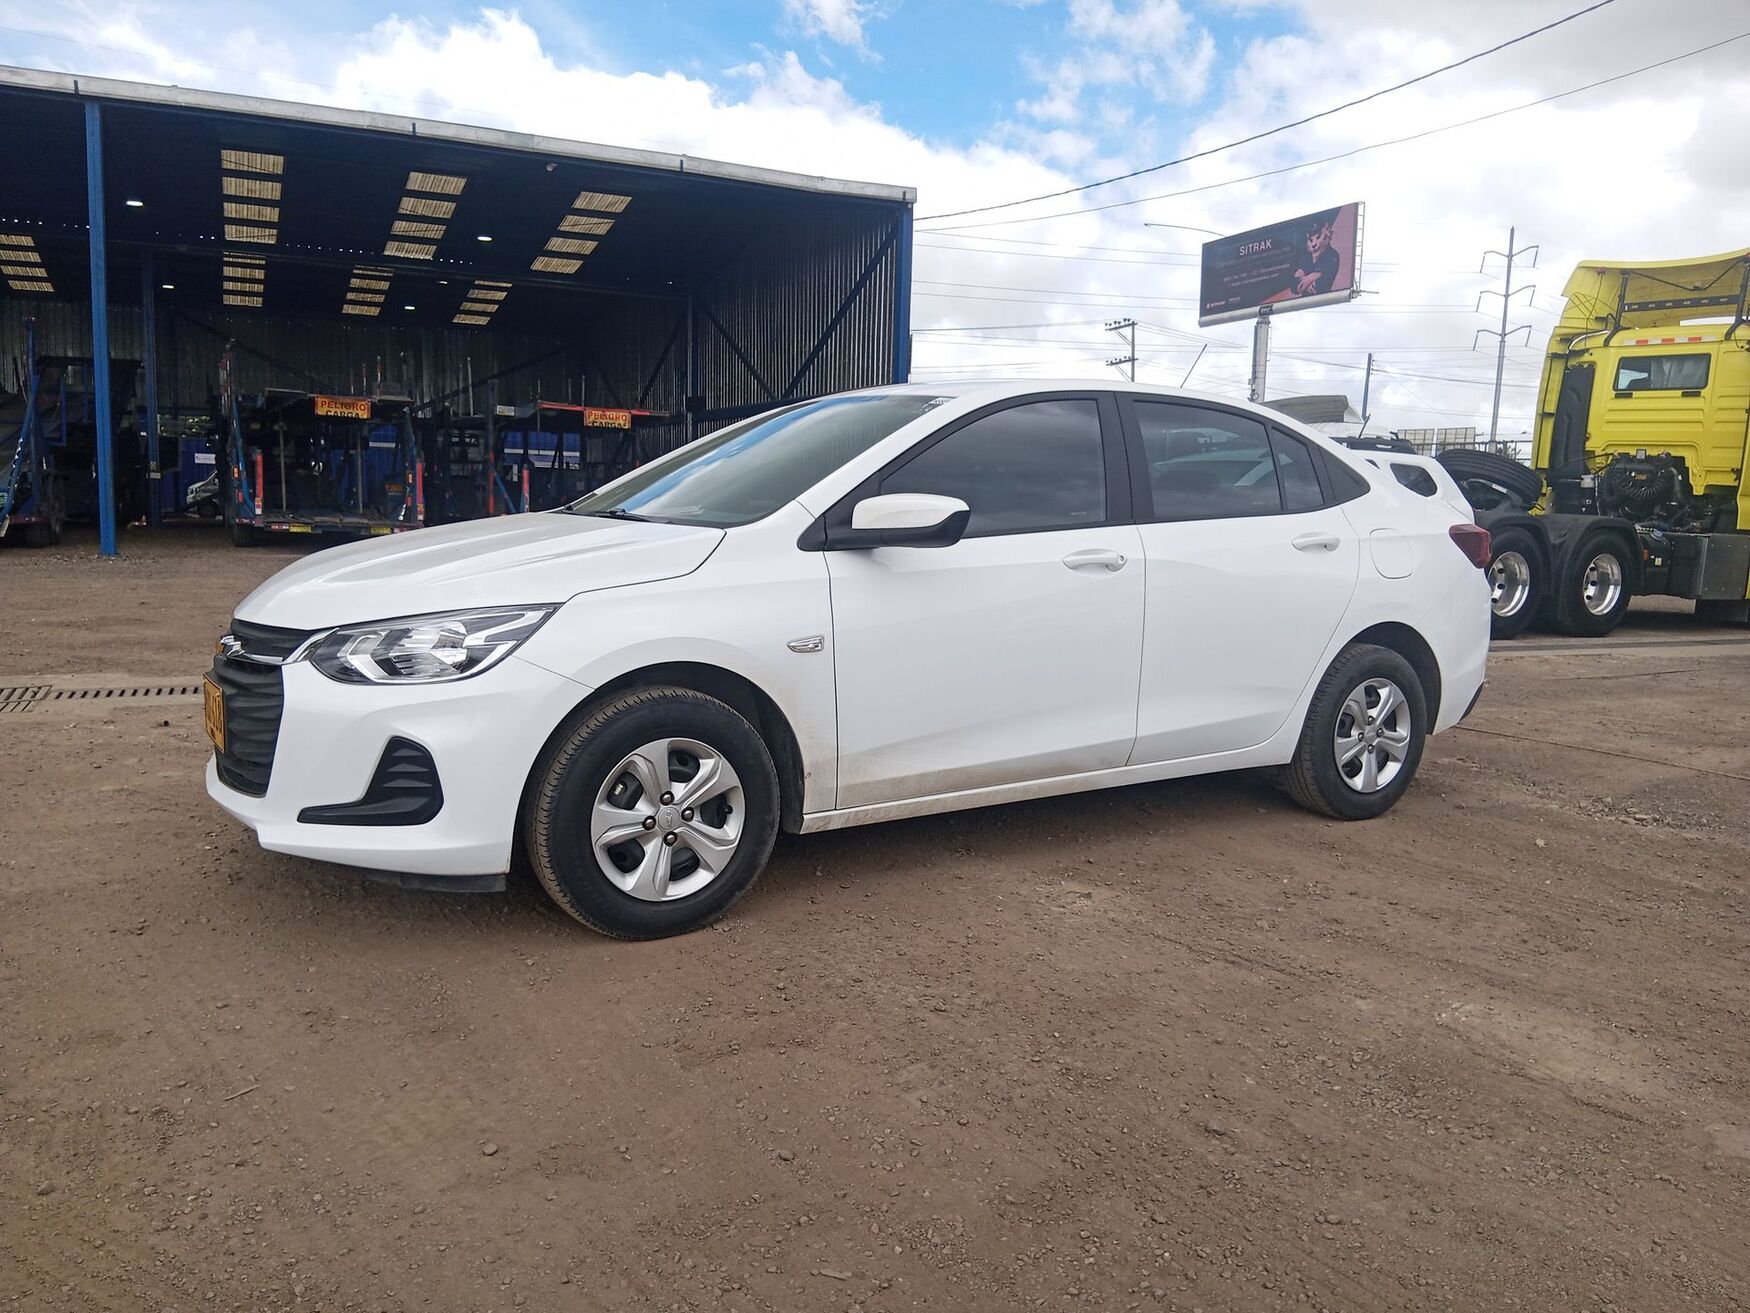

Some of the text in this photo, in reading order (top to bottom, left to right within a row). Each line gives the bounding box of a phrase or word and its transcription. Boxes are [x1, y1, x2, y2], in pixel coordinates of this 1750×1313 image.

[1239, 239, 1272, 256] SITRAK
[320, 400, 366, 411] PELIGRO
[588, 411, 627, 422] PELIGRO
